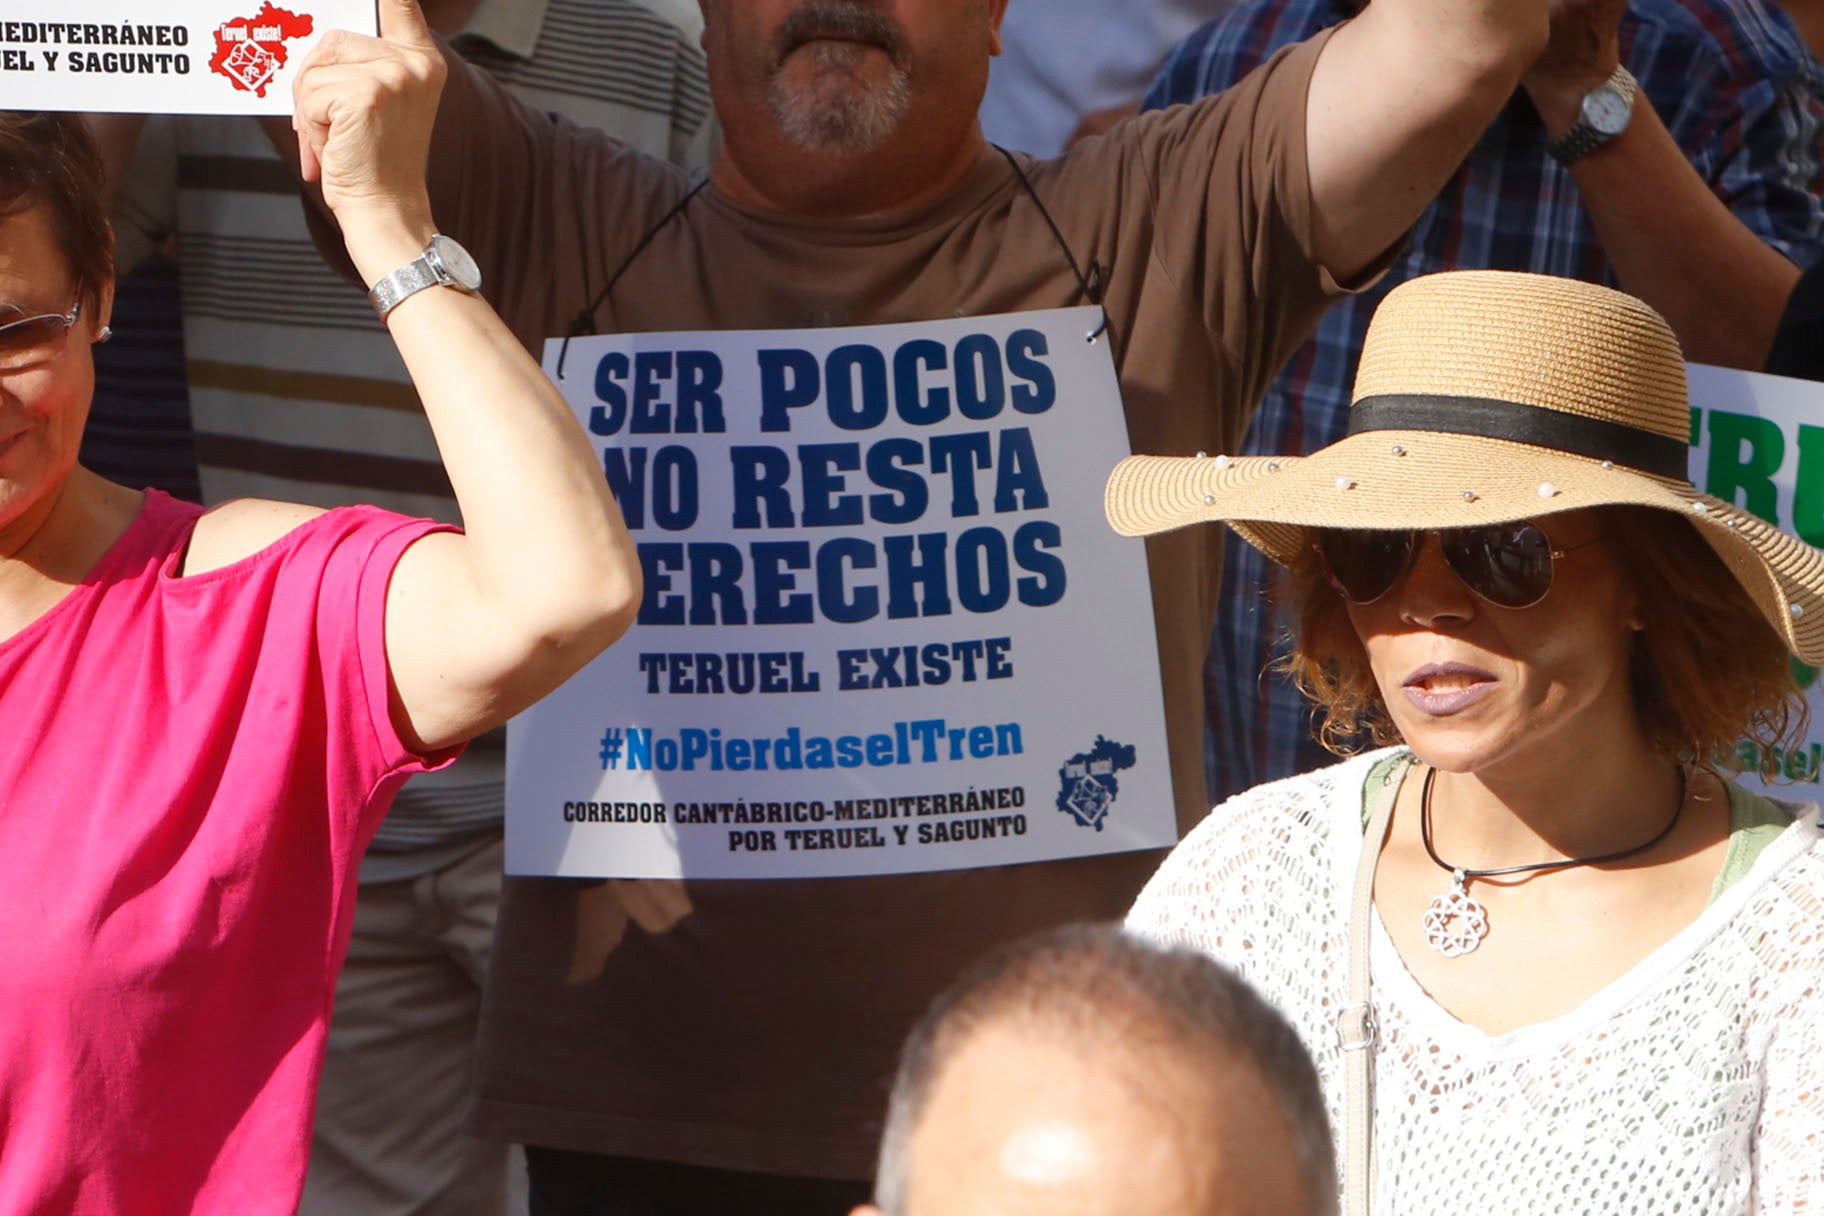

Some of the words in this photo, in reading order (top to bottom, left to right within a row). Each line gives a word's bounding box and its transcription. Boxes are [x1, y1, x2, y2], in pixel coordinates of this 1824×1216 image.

[43, 49, 60, 73] Y
[68, 50, 191, 76] SAGUNTO
[589, 350, 726, 436] SER
[758, 329, 1056, 433] POCOS
[603, 444, 699, 531] NO
[730, 427, 1049, 529] RESTA
[639, 651, 821, 695] TERUEL
[838, 637, 1014, 692] EXISTE
[599, 719, 1024, 772] #NoPierdaselTren
[563, 802, 667, 825] CORREDOR
[675, 786, 1026, 825] CANTÁBRICO-MEDITERRÁNEO
[729, 831, 777, 852] POR
[785, 828, 885, 852] TERUEL
[895, 825, 910, 846] Y
[919, 815, 1027, 844] SAGUNTO
